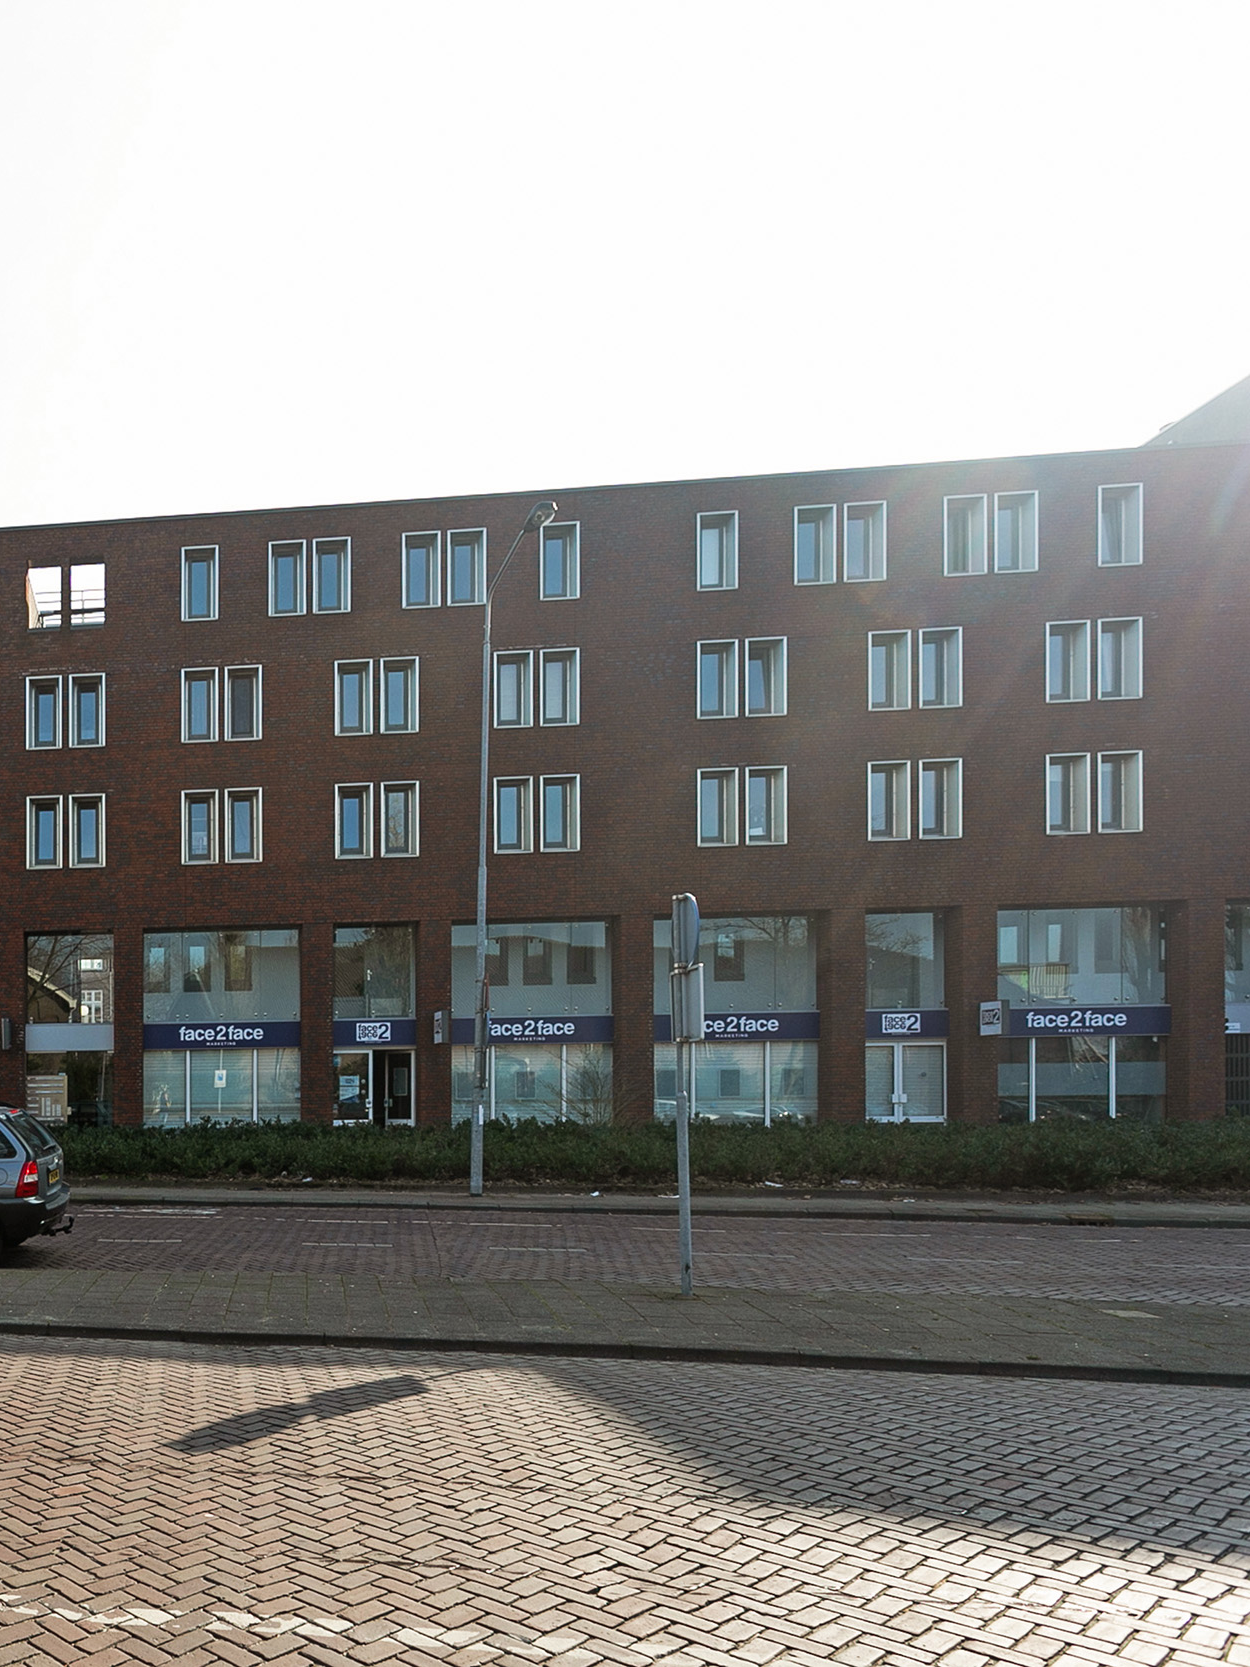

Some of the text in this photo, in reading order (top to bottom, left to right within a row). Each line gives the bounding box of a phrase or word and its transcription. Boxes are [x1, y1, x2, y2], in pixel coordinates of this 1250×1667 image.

[703, 1016, 780, 1032] ce2face
[906, 1014, 919, 1031] 2
[1026, 1010, 1128, 1028] face2face
[179, 1025, 264, 1041] face2face
[378, 1023, 389, 1039] 2
